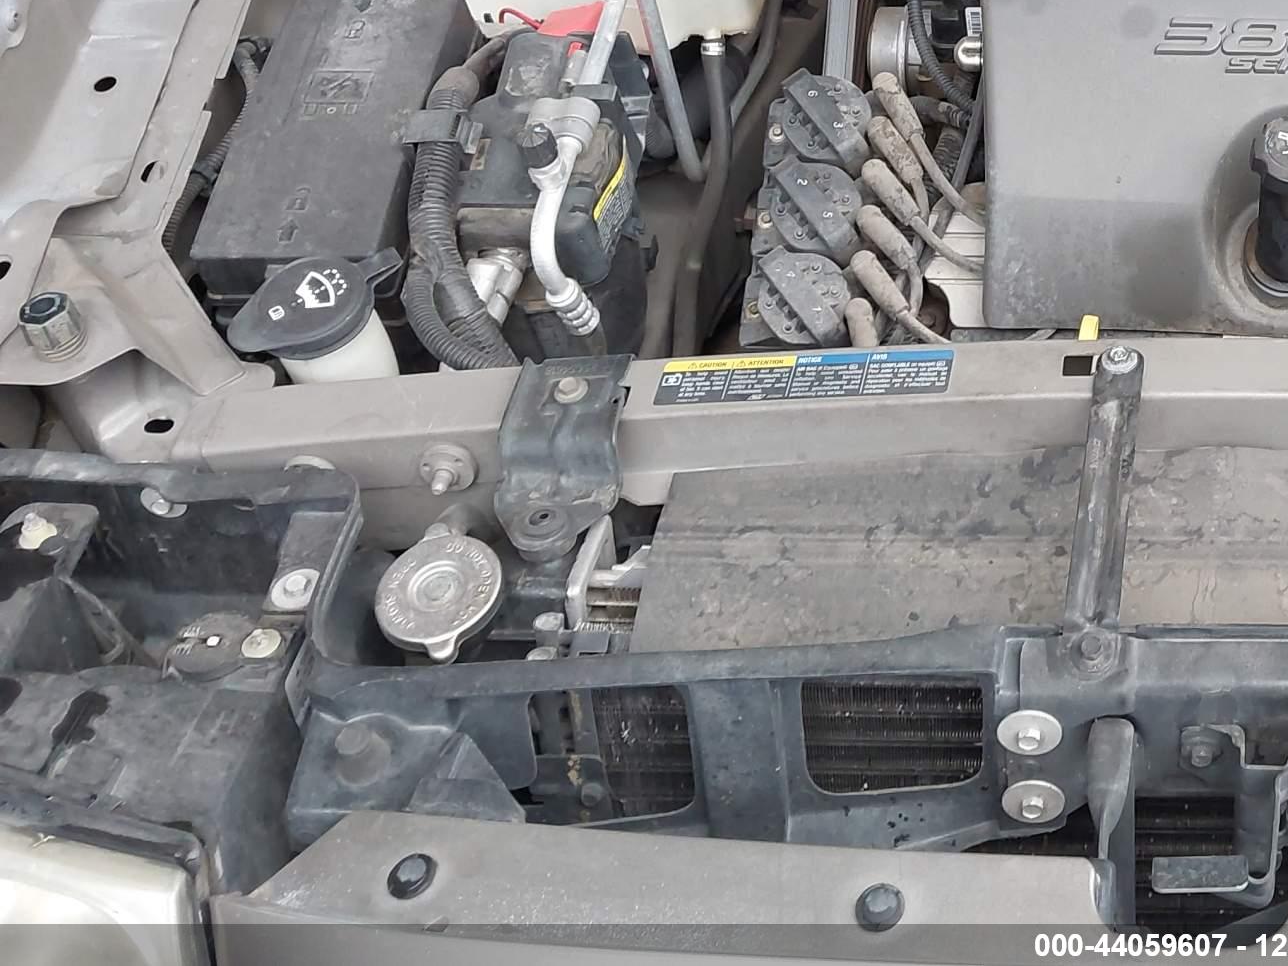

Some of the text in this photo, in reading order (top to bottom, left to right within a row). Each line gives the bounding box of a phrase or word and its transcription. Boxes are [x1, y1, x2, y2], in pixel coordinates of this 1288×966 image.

[796, 178, 808, 186] 2
[798, 356, 823, 364] NOTICE
[871, 353, 888, 361] AVIS
[698, 361, 727, 369] CAUTION
